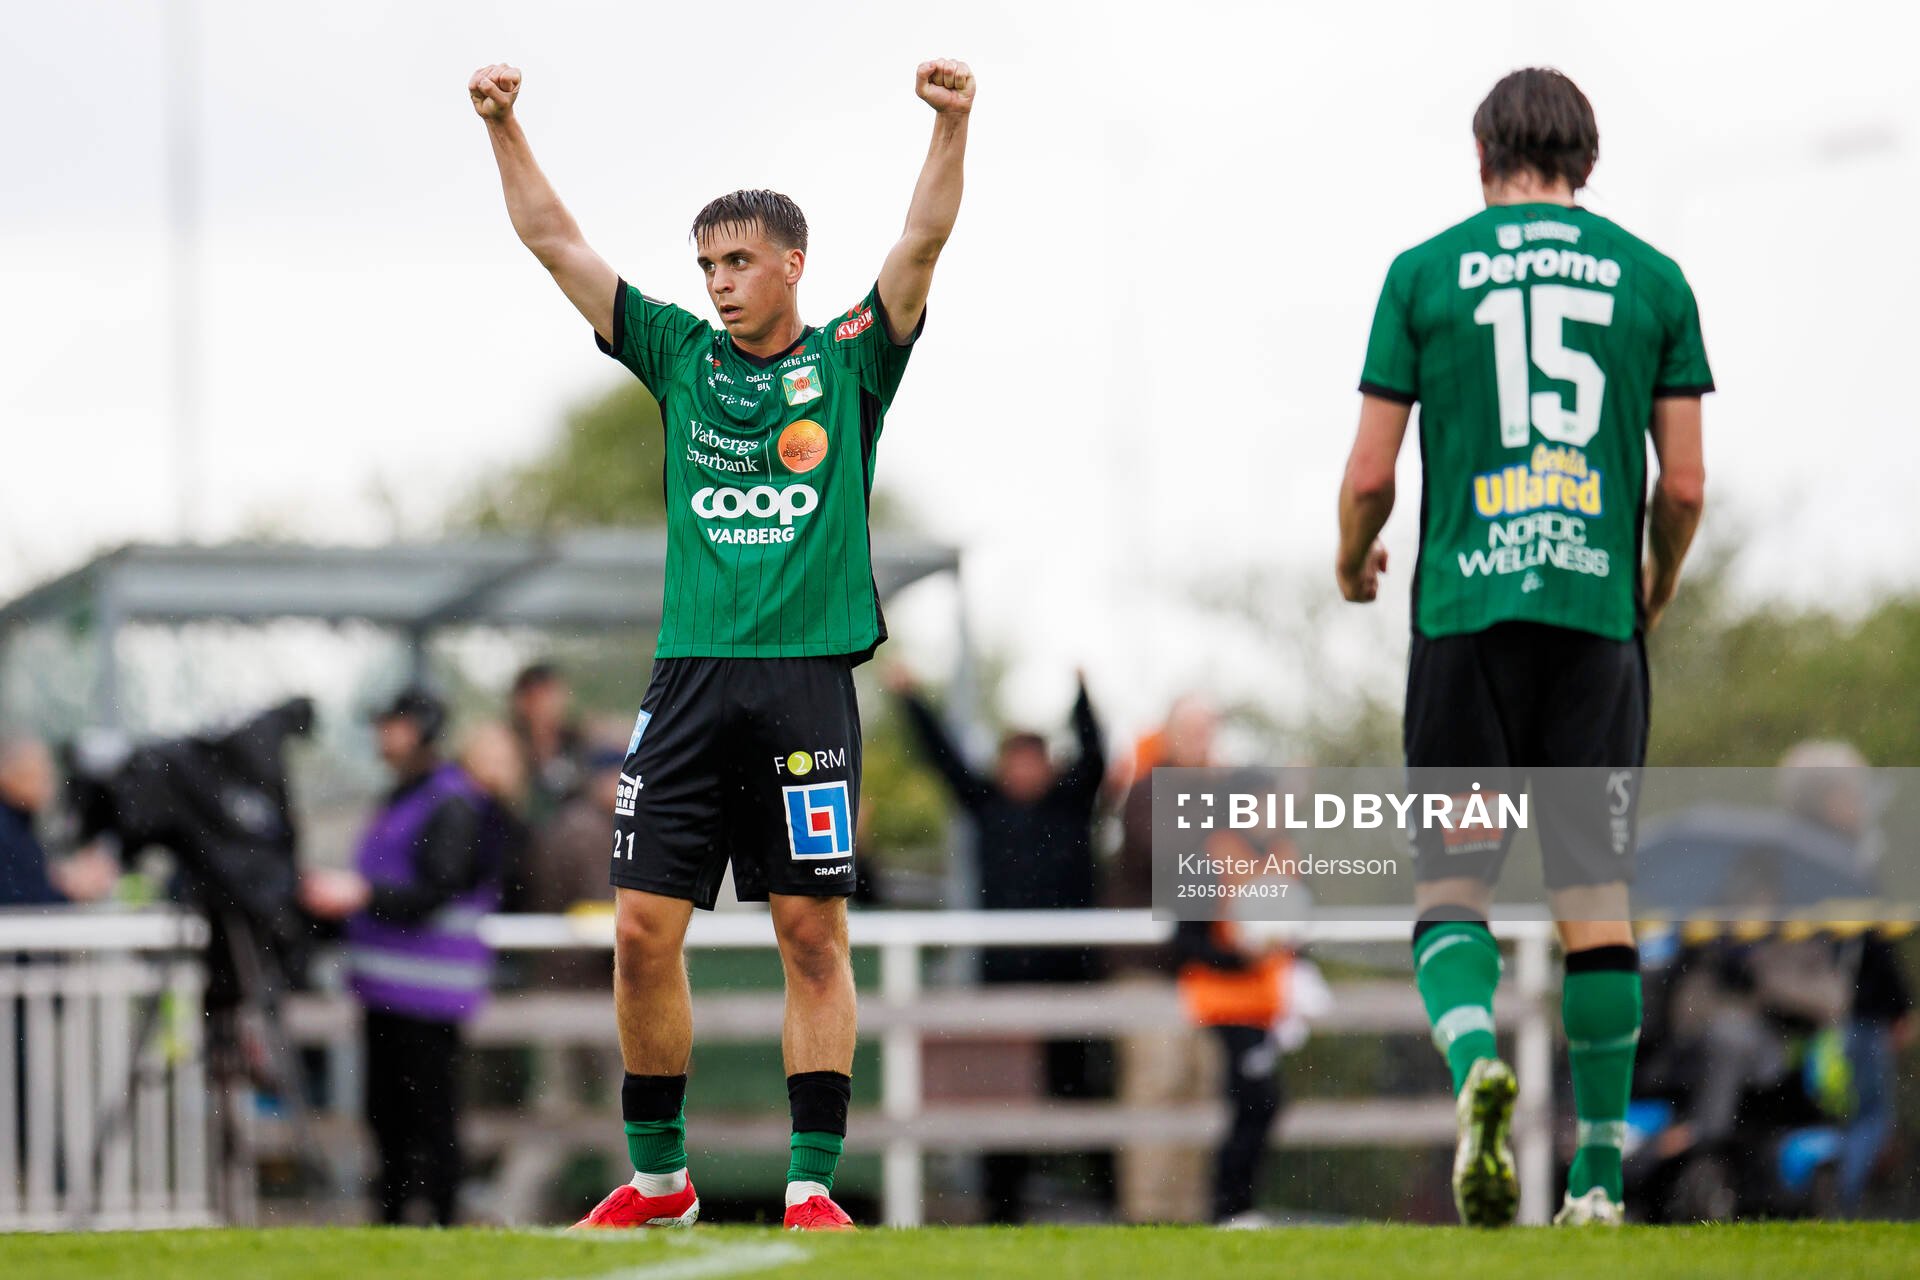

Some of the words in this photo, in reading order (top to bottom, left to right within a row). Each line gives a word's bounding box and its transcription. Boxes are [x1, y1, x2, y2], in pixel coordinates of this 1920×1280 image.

[1458, 248, 1621, 289] Derome
[1473, 284, 1615, 448] 15
[690, 420, 760, 456] Vabergs
[691, 483, 819, 526] coop
[1474, 465, 1602, 517] Ullared
[706, 527, 796, 545] VARBERG
[613, 829, 635, 861] 21
[814, 864, 848, 876] CRAFT
